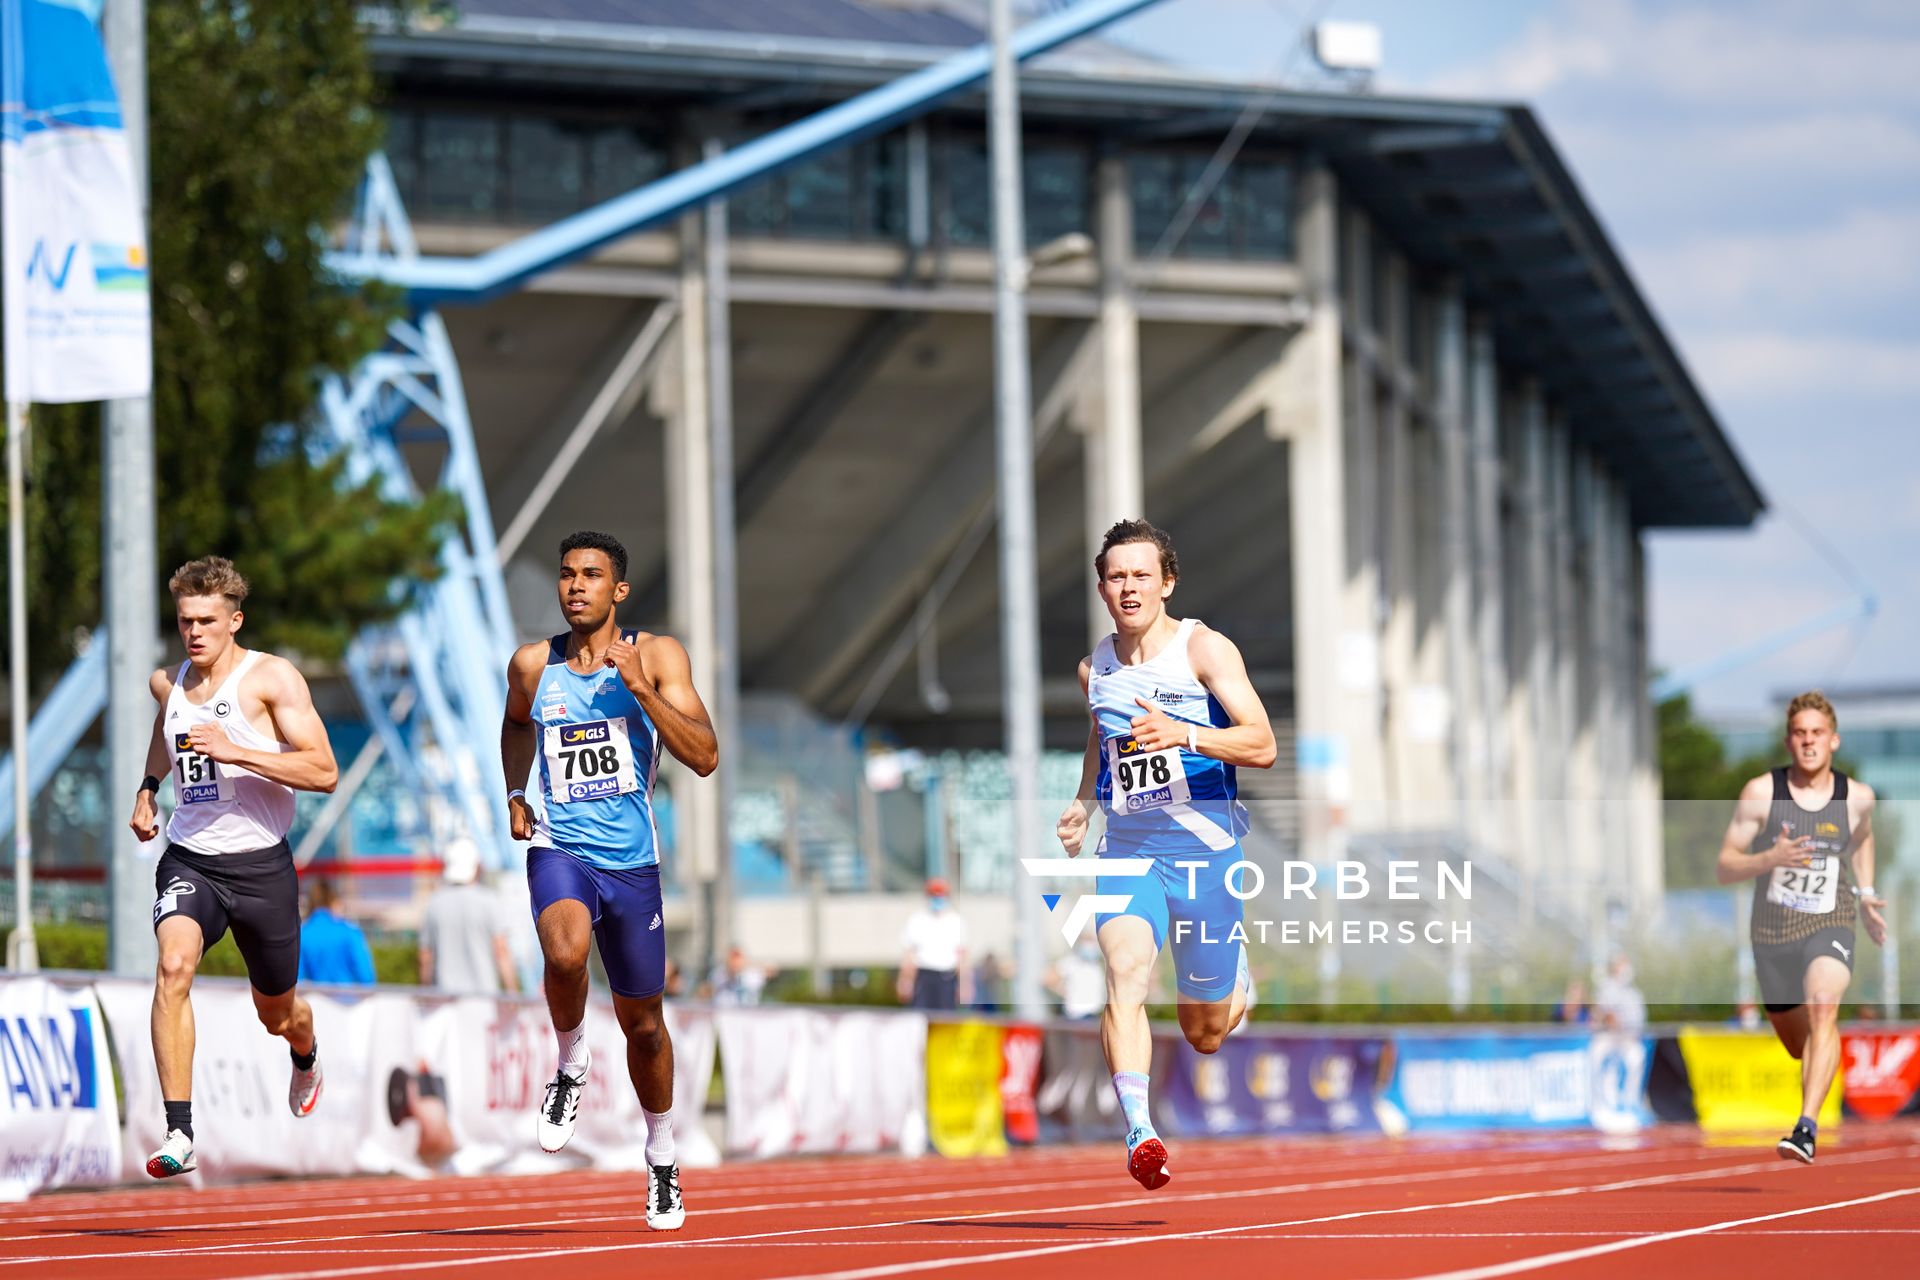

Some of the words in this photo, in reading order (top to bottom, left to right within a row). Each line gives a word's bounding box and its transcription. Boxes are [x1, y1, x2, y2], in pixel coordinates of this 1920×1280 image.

[585, 727, 606, 740] GLS
[176, 756, 217, 784] 151
[558, 745, 620, 780] 708
[1118, 754, 1171, 792] 978
[193, 787, 217, 798] PLAN
[588, 780, 617, 792] PLAN
[1143, 790, 1170, 803] PLAN
[1781, 870, 1827, 895] 212
